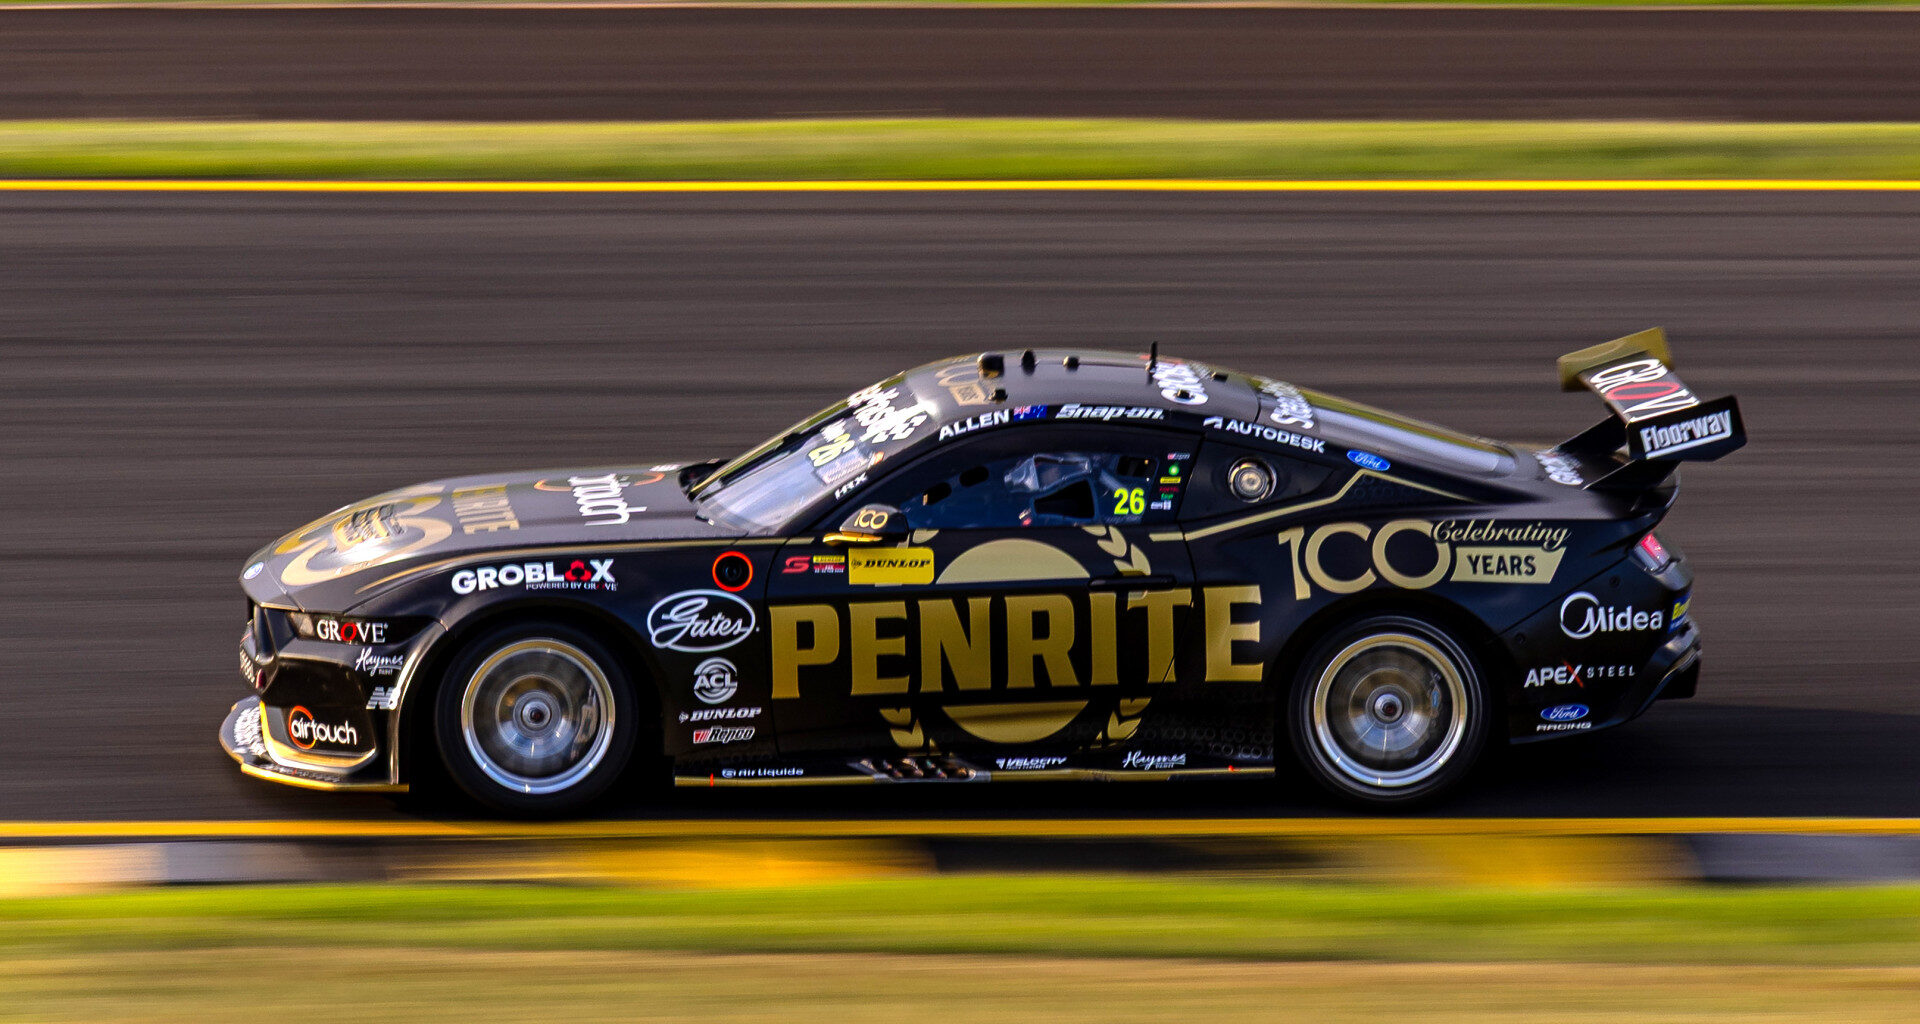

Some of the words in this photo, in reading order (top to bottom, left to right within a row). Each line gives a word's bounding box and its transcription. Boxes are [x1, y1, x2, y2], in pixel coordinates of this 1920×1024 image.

[939, 409, 1010, 441] ALLEN
[1226, 419, 1326, 454] AUTODESK
[1639, 409, 1732, 453] Floorway
[1352, 451, 1384, 470] Ford
[1114, 487, 1146, 515] 26
[1433, 519, 1570, 550] Celebrating
[451, 558, 615, 594] GROBLOX
[864, 559, 931, 568] DUNLOP
[1466, 554, 1537, 576] YEARS
[525, 582, 569, 590] POWERED
[570, 582, 582, 590] BY
[316, 619, 387, 644] GROVE
[652, 597, 750, 648] Gates
[1576, 604, 1664, 634] Midea
[769, 584, 1264, 699] PENRITE
[355, 646, 403, 677] Haymes
[1523, 661, 1584, 688] APEX
[1587, 665, 1636, 679] STEEL
[694, 672, 738, 690] ACL
[690, 707, 762, 722] DUNLOP
[1548, 705, 1581, 720] Ford
[291, 717, 357, 745] airtouch
[708, 725, 755, 743] Repco
[738, 768, 756, 777] Air
[757, 767, 804, 777] Liquide
[1006, 756, 1068, 767] VELOCITY
[1122, 750, 1186, 770] Haymes
